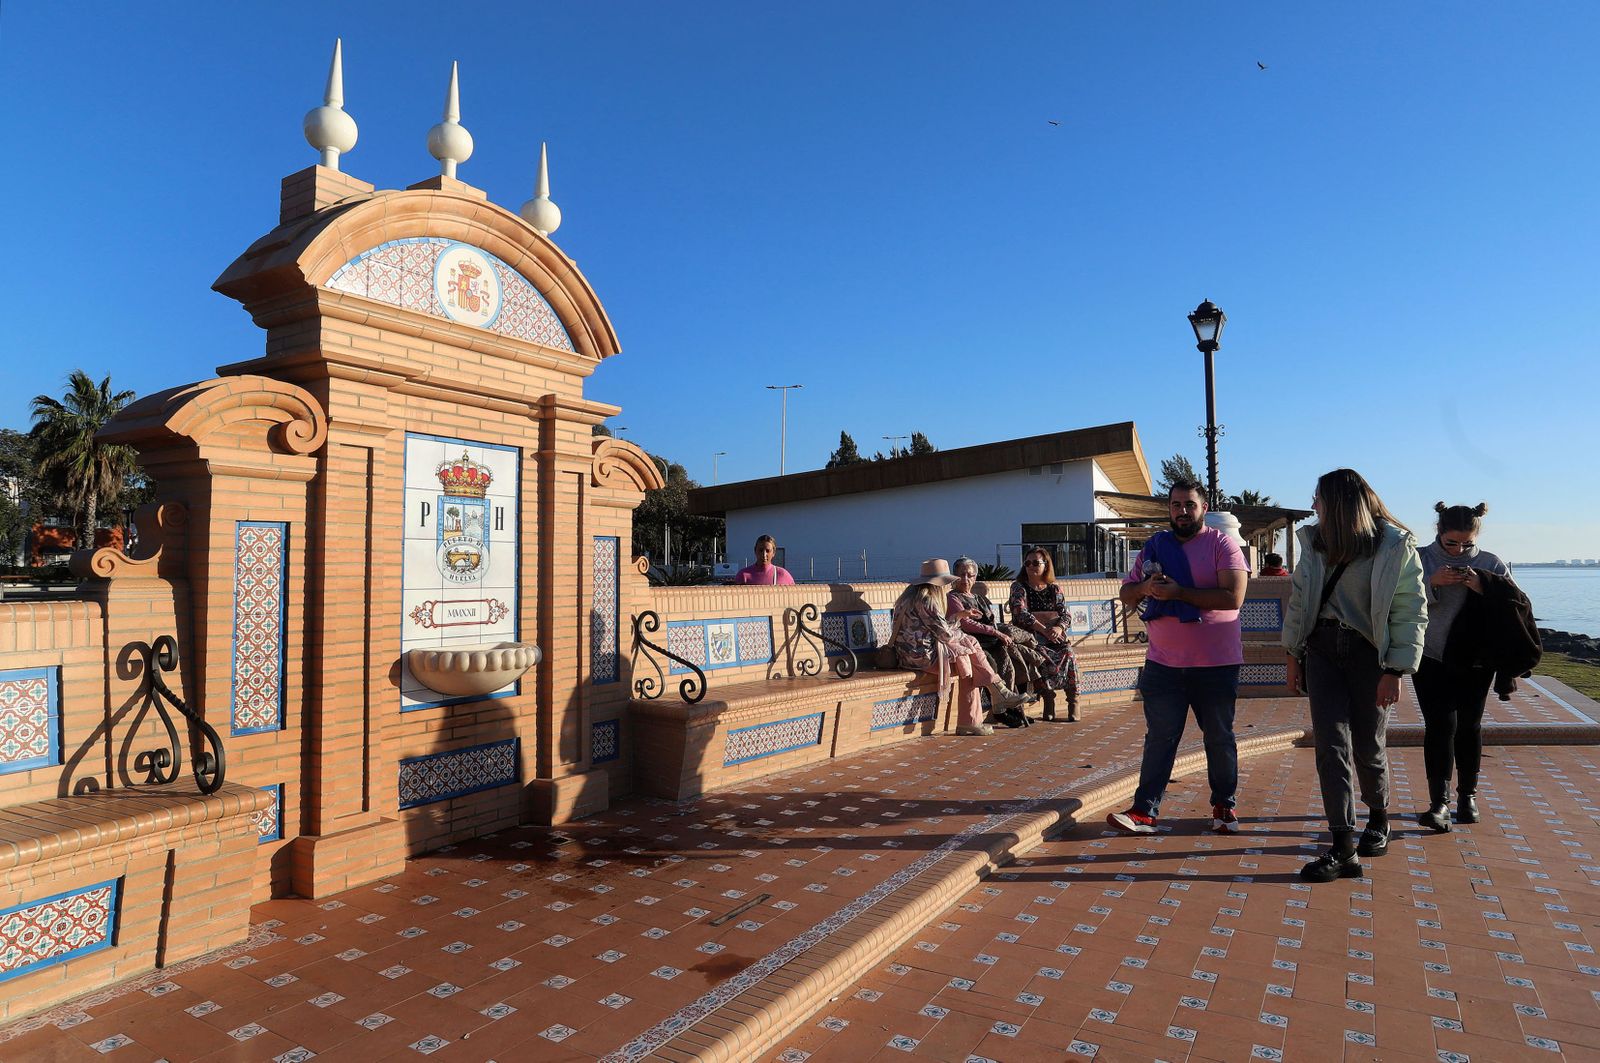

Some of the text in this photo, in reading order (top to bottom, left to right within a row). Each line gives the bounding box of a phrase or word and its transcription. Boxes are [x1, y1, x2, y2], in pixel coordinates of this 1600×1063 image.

[420, 501, 431, 527] P
[494, 506, 505, 531] H
[443, 536, 484, 550] PUERTO DE
[449, 574, 476, 582] HUELVA
[447, 608, 476, 618] MMXXII
